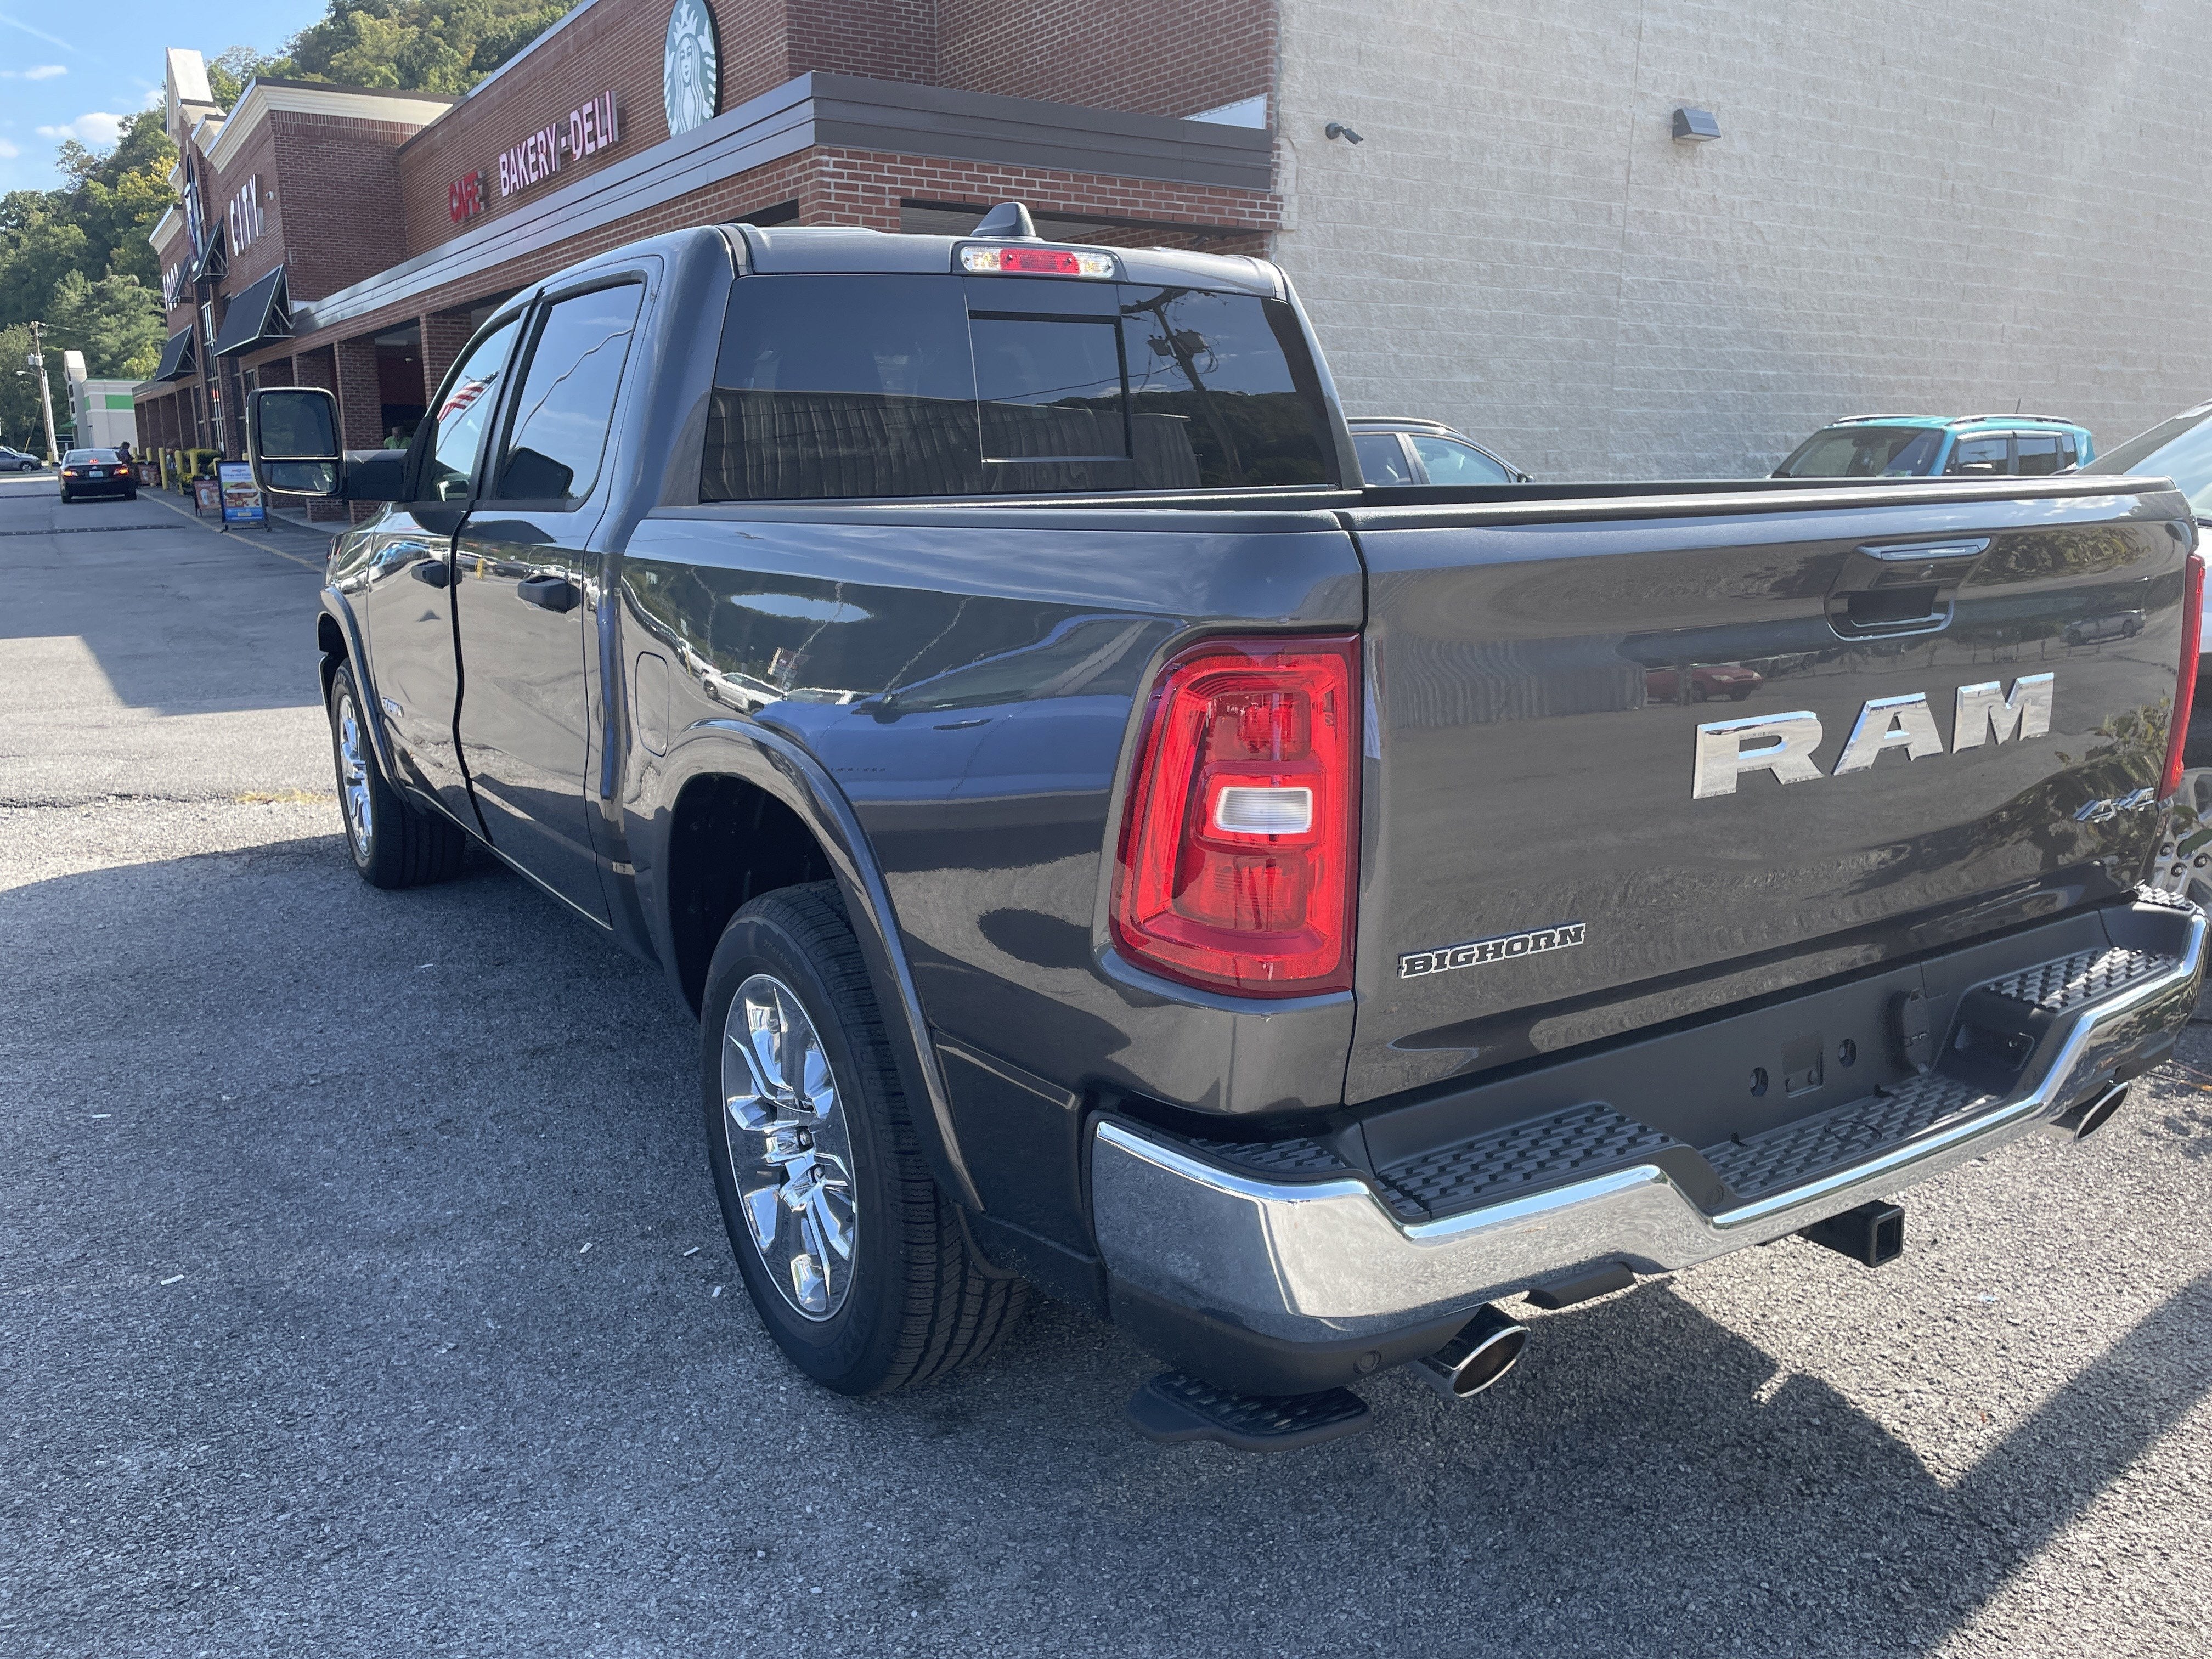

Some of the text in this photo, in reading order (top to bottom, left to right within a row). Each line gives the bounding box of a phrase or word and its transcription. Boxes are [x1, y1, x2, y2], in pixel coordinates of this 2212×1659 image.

[230, 174, 259, 257] CITY
[1692, 672, 2054, 800] RAM
[1401, 923, 1587, 979] BIGHORN
